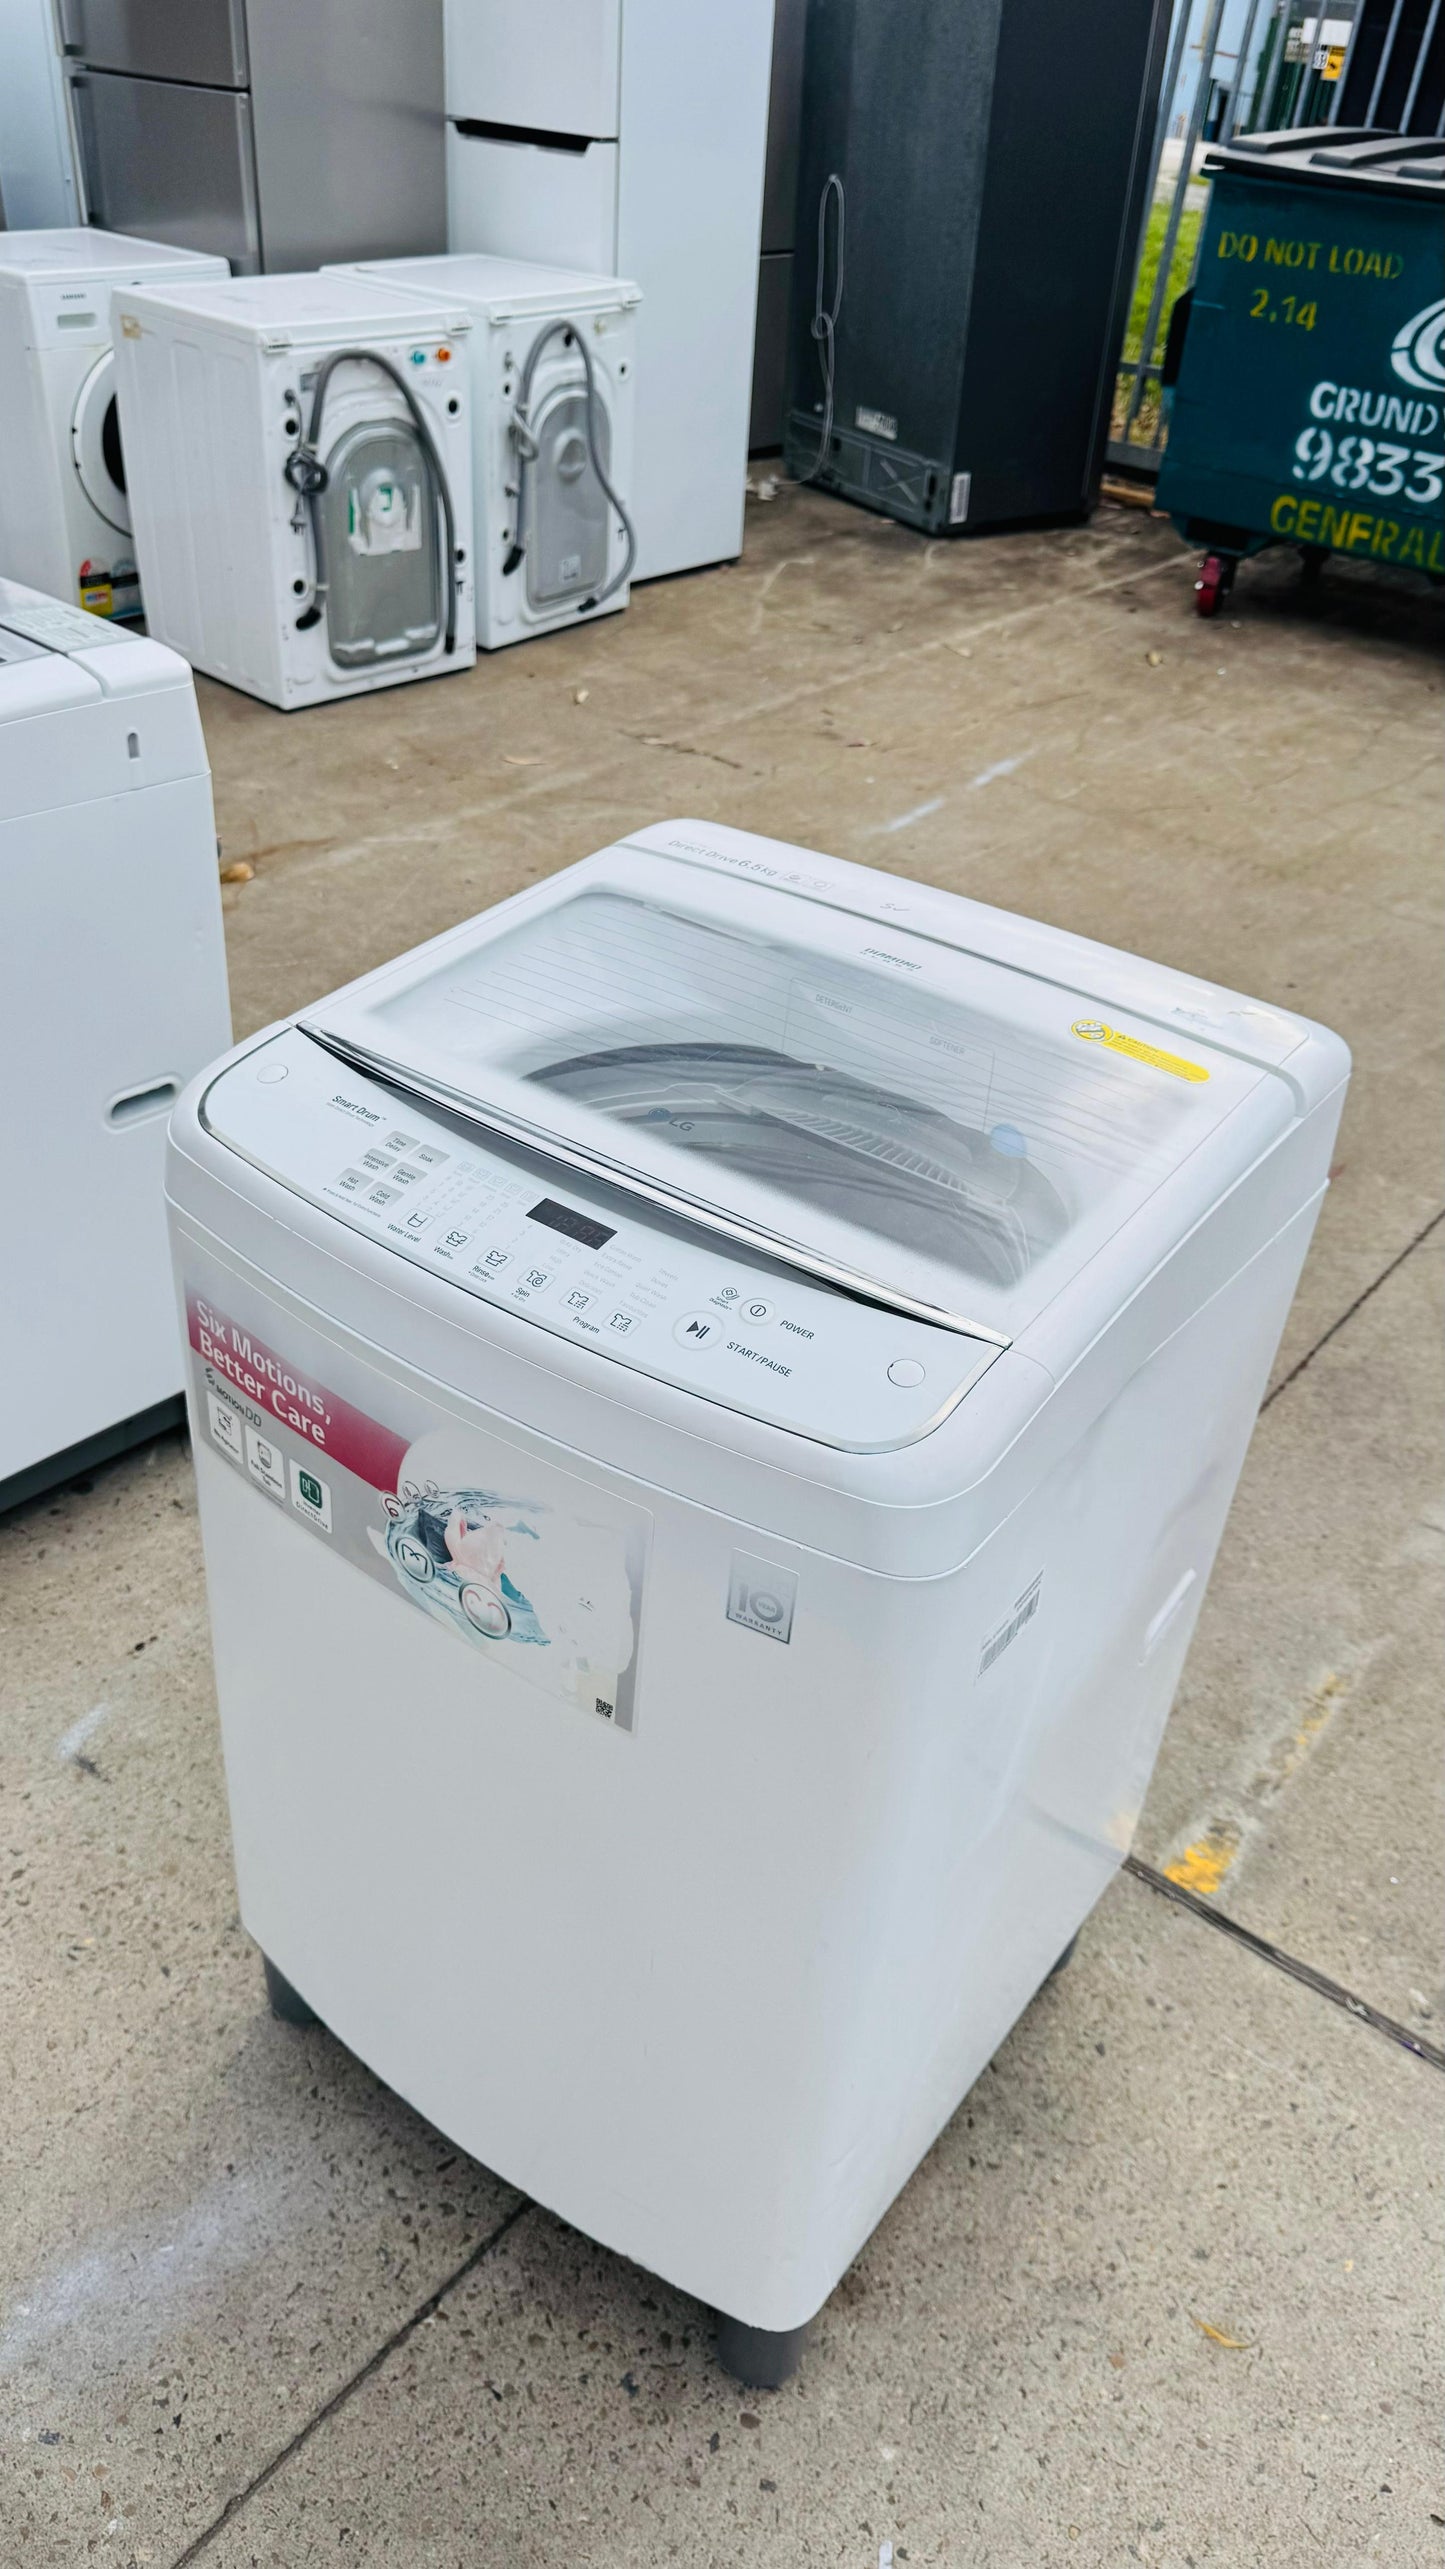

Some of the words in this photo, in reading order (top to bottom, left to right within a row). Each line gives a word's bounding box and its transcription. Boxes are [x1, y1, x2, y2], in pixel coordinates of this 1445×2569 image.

[1217, 231, 1259, 262] DO
[1264, 238, 1323, 270] NOT
[1328, 246, 1405, 279] LOAD
[1249, 289, 1318, 331] 2.14
[1310, 381, 1445, 437] GRUND
[332, 1095, 359, 1111] Smart
[668, 1117, 696, 1132] LG
[362, 1160, 379, 1171] Wash
[338, 1180, 356, 1192] Wash
[392, 1174, 410, 1186] Wash
[368, 1194, 387, 1207] Wash
[387, 1223, 406, 1236] Water
[403, 1231, 422, 1243] Level
[434, 1246, 451, 1259] Wash
[472, 1265, 489, 1278] Rinse
[515, 1286, 531, 1299] Spin
[573, 1316, 600, 1335] Program
[780, 1319, 815, 1341] POWER
[197, 1300, 227, 1344] Six
[231, 1326, 332, 1426] Motions,
[727, 1341, 793, 1378] START/PAUSE
[200, 1328, 266, 1400] Better
[271, 1389, 326, 1446] Care
[738, 1582, 785, 1623] 10
[735, 1612, 784, 1637] WARRANTY
